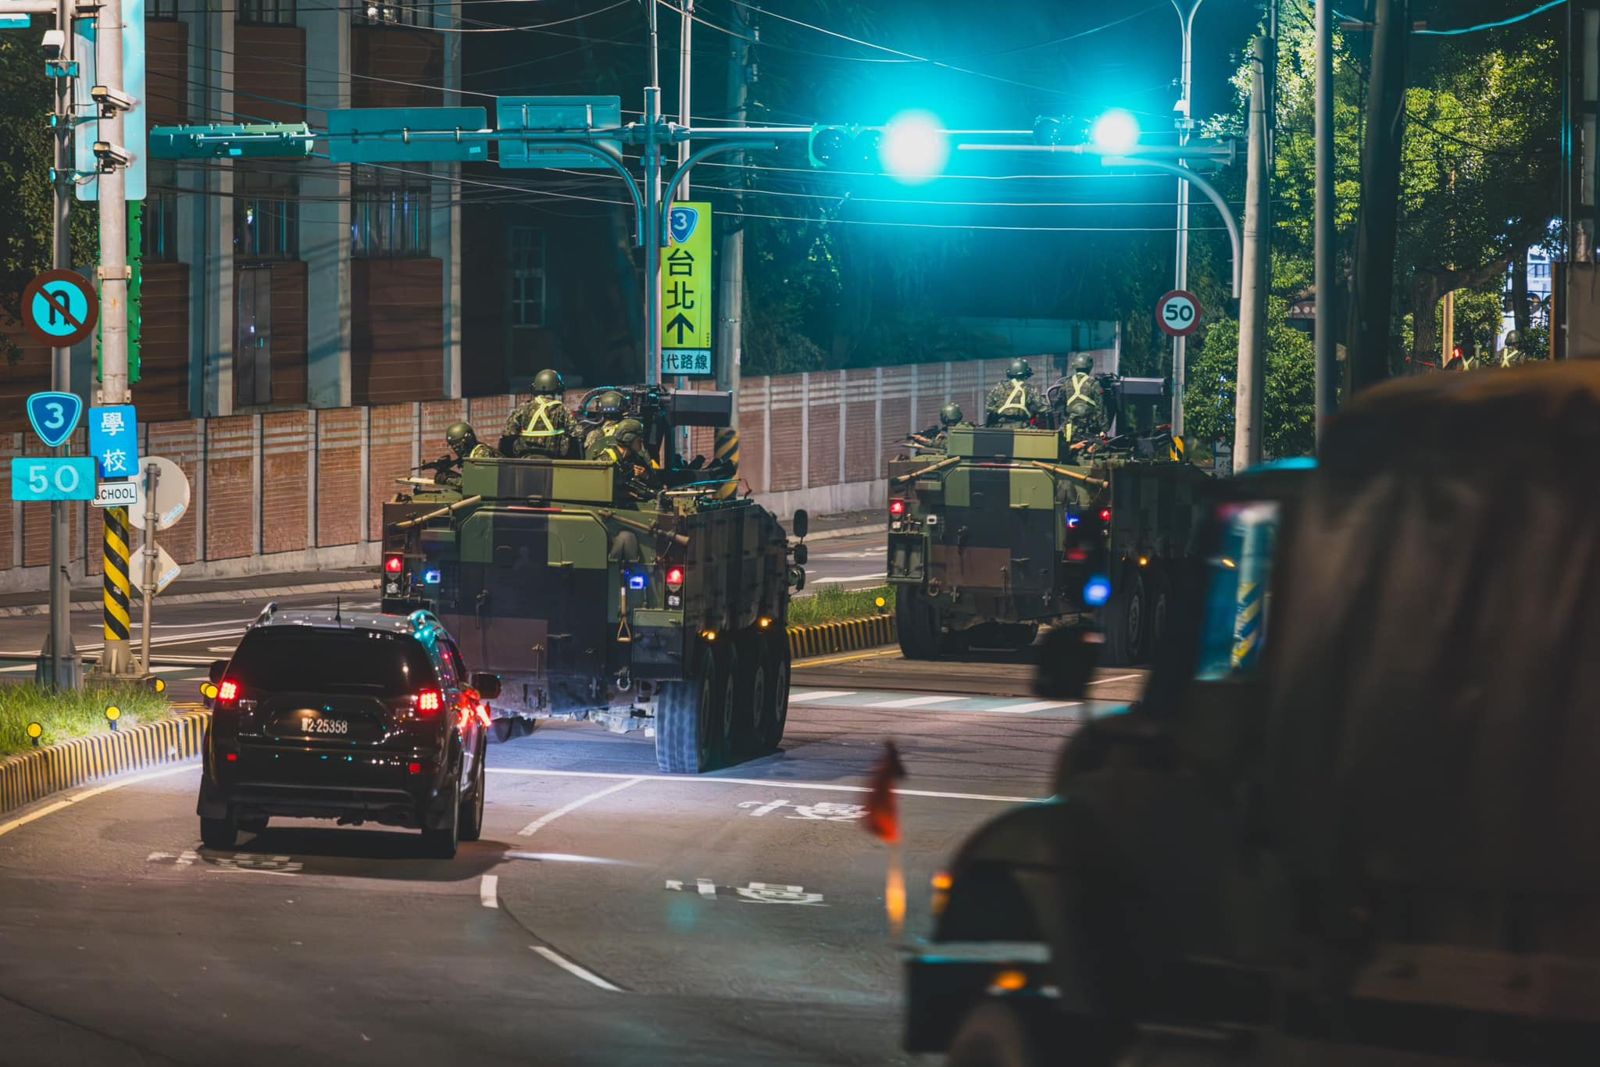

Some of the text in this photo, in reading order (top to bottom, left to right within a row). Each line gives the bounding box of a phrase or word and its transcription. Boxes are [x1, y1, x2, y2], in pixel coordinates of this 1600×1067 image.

[674, 212, 687, 230] 3
[666, 248, 694, 309] 台北
[1165, 304, 1193, 321] 50
[44, 402, 64, 429] 3
[101, 412, 127, 472] 學校
[29, 464, 79, 493] 50
[301, 717, 348, 734] 2-25358
